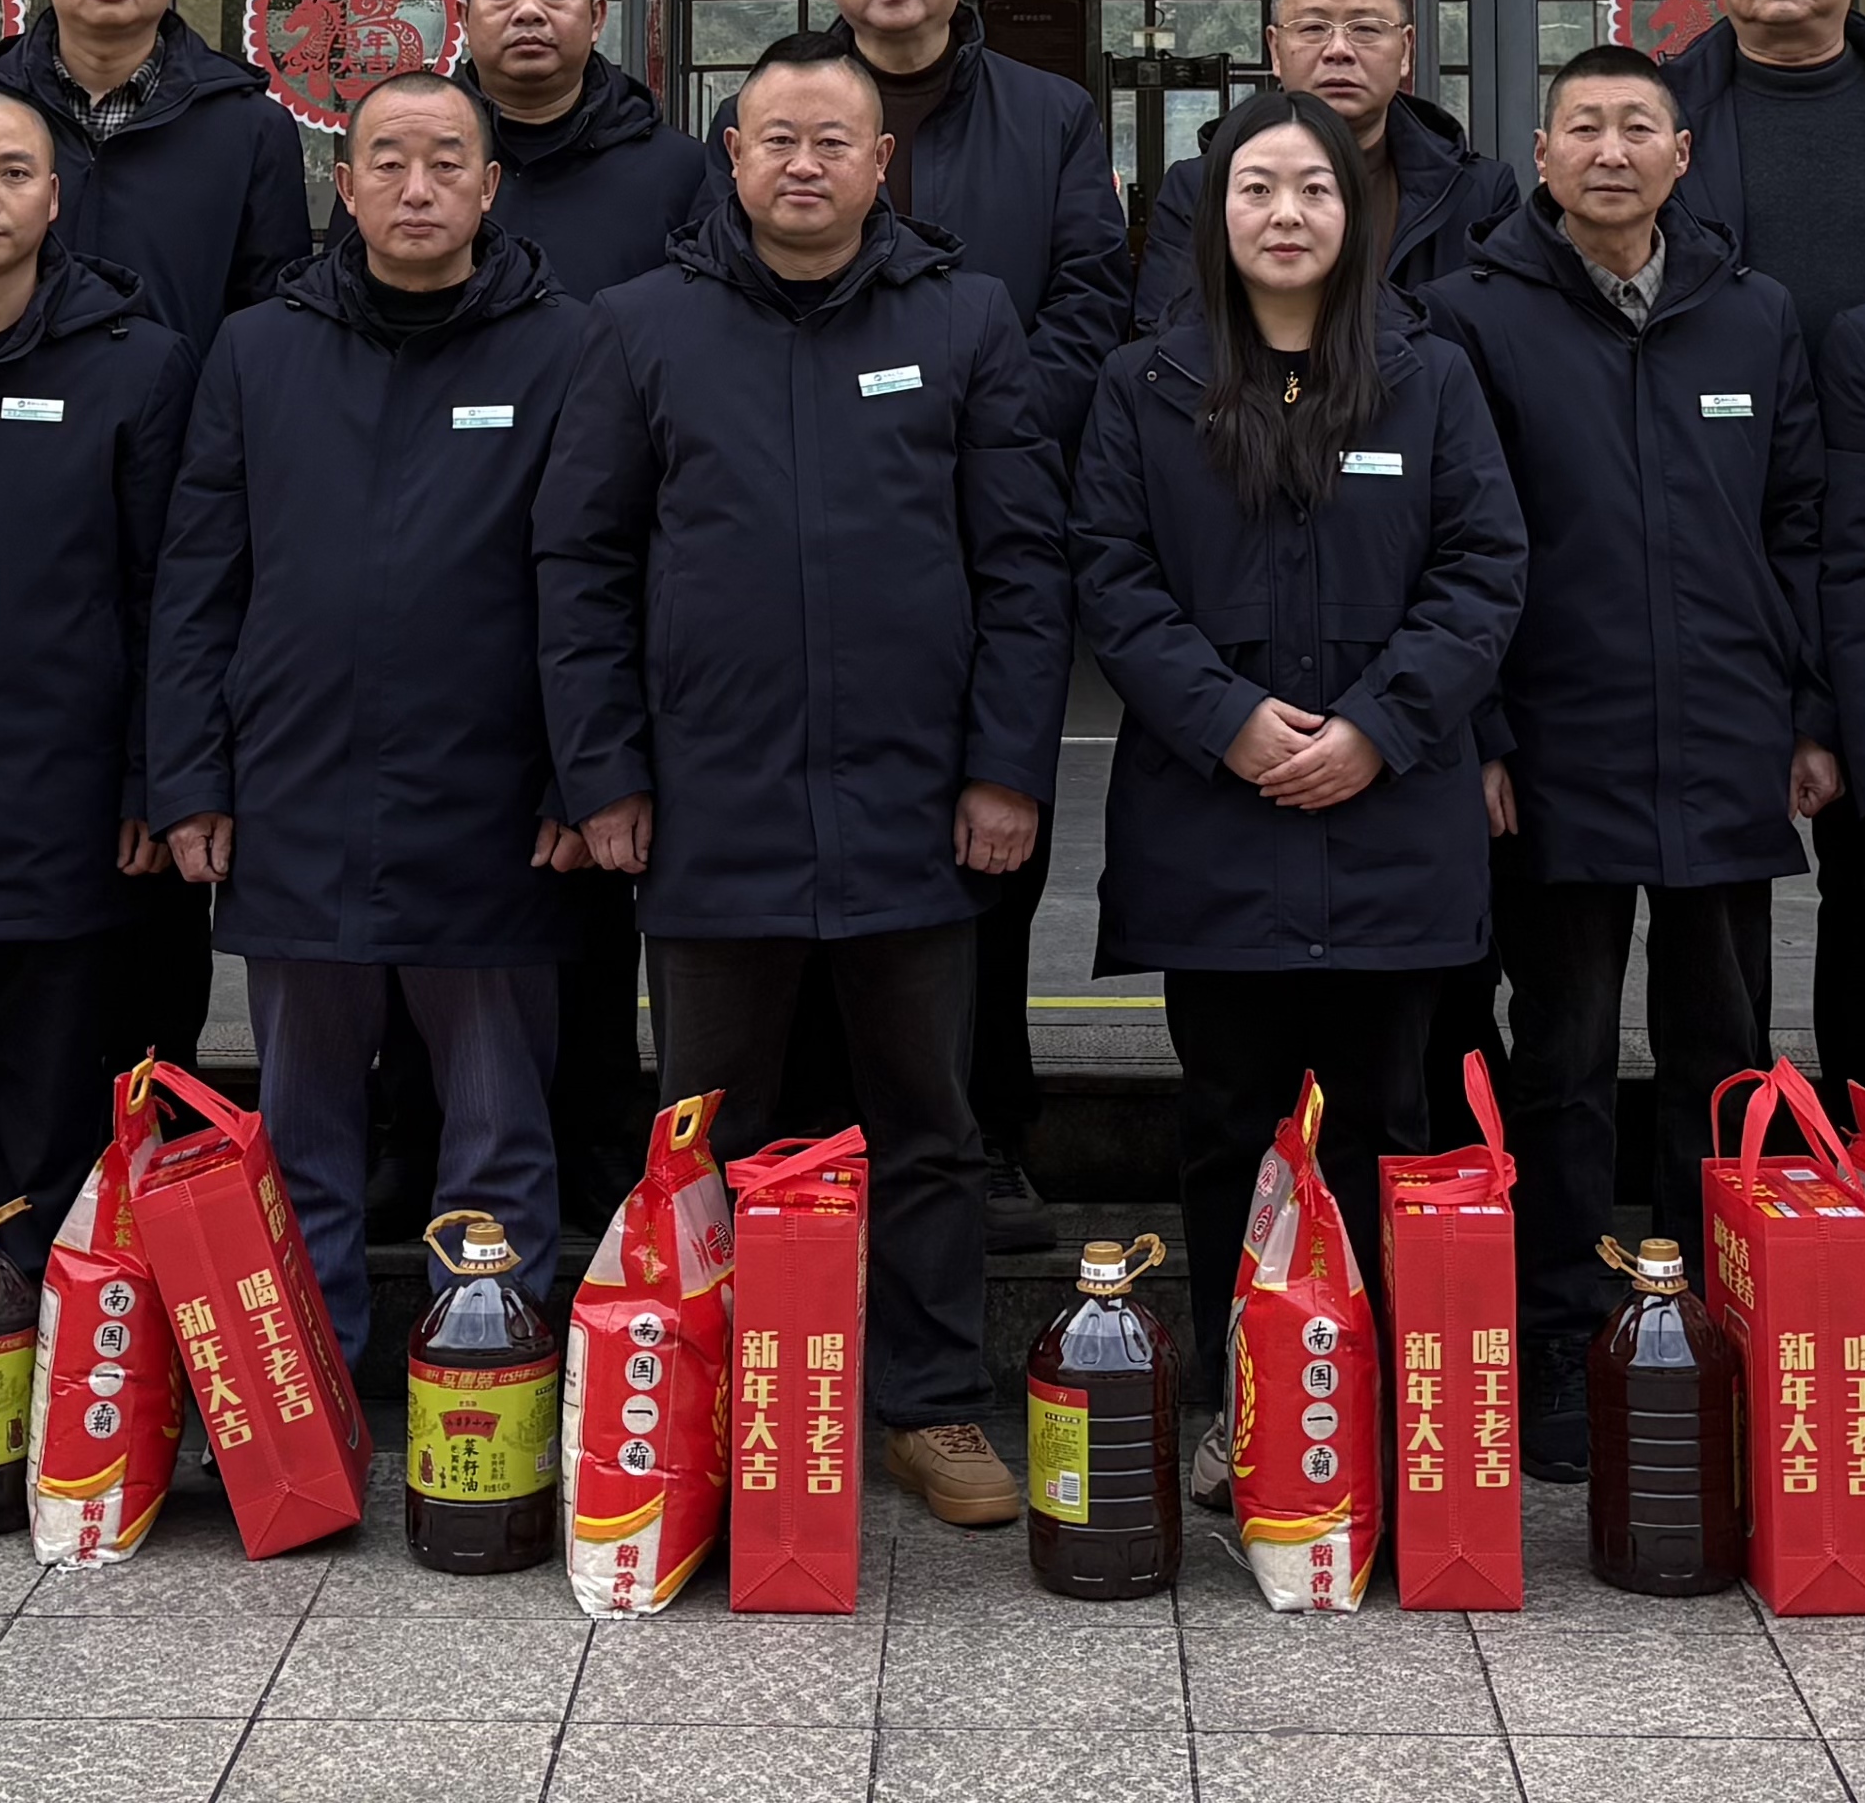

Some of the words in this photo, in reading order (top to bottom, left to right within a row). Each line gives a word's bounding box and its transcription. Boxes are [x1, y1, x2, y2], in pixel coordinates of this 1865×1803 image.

[88, 1283, 131, 1435] 南国一霸
[174, 1295, 253, 1450] 新年大吉
[236, 1269, 315, 1424] 喝王老吉
[624, 1315, 661, 1473] 南国一霸
[742, 1330, 778, 1490] 新年大吉
[807, 1333, 843, 1494] 喝王老吉
[1306, 1320, 1336, 1481] 南国一霸
[1405, 1332, 1443, 1492] 新年大吉
[1472, 1329, 1510, 1488] 喝王老吉
[1779, 1332, 1818, 1493] 新年大吉
[461, 1437, 480, 1494] 菜籽油
